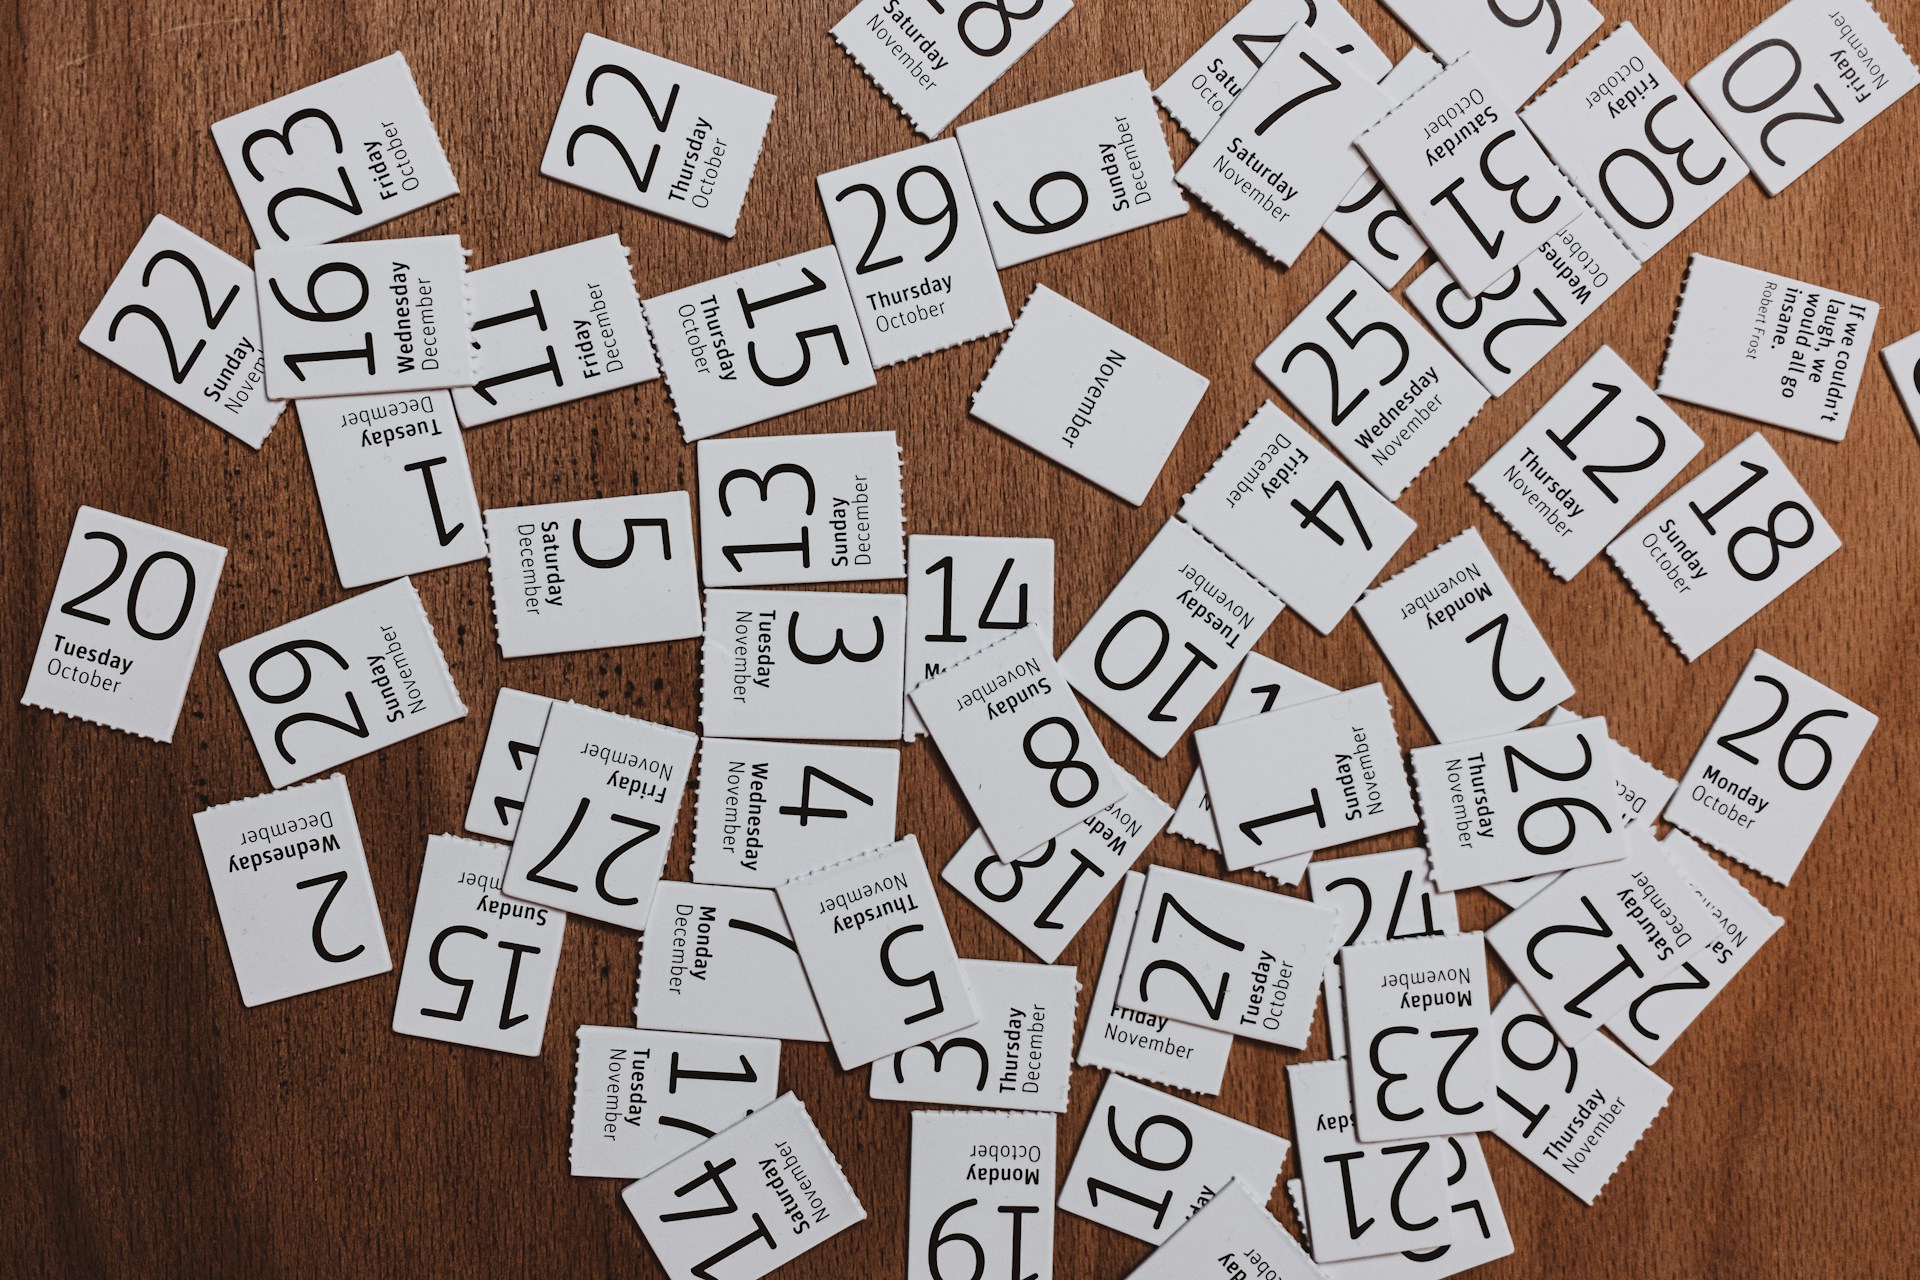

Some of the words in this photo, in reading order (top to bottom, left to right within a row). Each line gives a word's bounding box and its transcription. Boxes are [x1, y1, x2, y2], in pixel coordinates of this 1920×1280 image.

[866, 13, 937, 91] November
[883, 0, 949, 70] Saturday
[926, 0, 1044, 57] 8
[1828, 11, 1889, 90] November
[1191, 74, 1224, 113] Octo
[1207, 58, 1242, 98] Satu
[1254, 51, 1342, 137] 7
[1585, 56, 1644, 109] October
[1607, 72, 1660, 119] Friday
[1722, 38, 1845, 167] 20
[1829, 49, 1872, 103] Friday
[566, 64, 680, 193] 22
[1424, 88, 1484, 140] October
[1426, 106, 1498, 167] Saturday
[241, 108, 363, 242] 23
[363, 141, 398, 200] Friday
[381, 122, 419, 191] October
[668, 116, 713, 201] Thursday
[691, 137, 727, 208] October
[1098, 144, 1130, 212] Sunday
[1114, 116, 1152, 205] December
[1213, 154, 1290, 222] November
[1226, 137, 1299, 201] Saturday
[1598, 94, 1727, 230] 30
[835, 165, 958, 275] 29
[992, 170, 1089, 235] 6
[1430, 129, 1562, 260] 31
[866, 275, 951, 311] Thursday
[1538, 241, 1592, 305] Wednes
[1555, 229, 1608, 288] October
[108, 249, 241, 385] 22
[268, 262, 376, 382] 16
[389, 261, 415, 374] Wednesday
[415, 277, 439, 370] December
[587, 283, 624, 373] December
[678, 304, 710, 373] October
[700, 294, 737, 380] Thursday
[736, 267, 850, 387] 15
[876, 302, 945, 333] October
[1436, 264, 1567, 375] 28
[1755, 281, 1778, 324] Robert
[1771, 287, 1803, 349] insane.
[1795, 294, 1820, 348] would
[1814, 299, 1846, 352] laugh,
[1841, 323, 1858, 346] we
[1848, 303, 1867, 321] If
[203, 336, 255, 403] Sunday
[470, 289, 564, 406] 11
[573, 320, 601, 379] Friday
[1281, 289, 1410, 427] 25
[1746, 327, 1765, 359] Frost
[1788, 350, 1807, 373] all
[1808, 359, 1826, 383] we
[224, 349, 266, 415] Novem
[341, 396, 434, 428] December
[1062, 349, 1127, 449] November
[1354, 366, 1439, 449] Wednesday
[1780, 375, 1797, 398] go
[361, 419, 443, 448] Tuesday
[1371, 394, 1442, 466] November
[1545, 382, 1666, 504] 12
[404, 456, 465, 547] 1
[1226, 433, 1292, 509] December
[1261, 448, 1309, 499] Friday
[1503, 465, 1573, 537] November
[1519, 446, 1584, 518] Thursday
[572, 518, 672, 569] 5
[718, 463, 816, 573] 13
[828, 497, 850, 567] Sunday
[851, 475, 871, 565] December
[1290, 480, 1373, 551] 4
[1659, 519, 1708, 579] Sunday
[1688, 460, 1815, 582] 18
[60, 531, 196, 641] 20
[517, 524, 542, 615] December
[541, 521, 566, 606] Saturday
[924, 555, 1029, 643] 14
[1178, 564, 1255, 630] November
[1401, 563, 1481, 620] November
[1642, 533, 1691, 593] October
[787, 611, 885, 665] 3
[1176, 589, 1240, 650] Tuesday
[1426, 582, 1493, 630] Monday
[47, 658, 122, 693] October
[54, 634, 134, 675] Tuesday
[380, 626, 427, 714] November
[733, 611, 753, 704] November
[752, 609, 776, 688] Tuesday
[957, 657, 1041, 711] November
[1094, 609, 1218, 722] 10
[1465, 613, 1546, 702] 2
[248, 639, 370, 765] 29
[366, 655, 405, 723] Sunday
[987, 677, 1052, 720] Sunday
[580, 743, 673, 782] November
[1022, 716, 1100, 809] 8
[1716, 675, 1849, 791] 26
[606, 770, 667, 804] Friday
[779, 765, 874, 827] 4
[1335, 754, 1362, 821] Sunday
[1351, 726, 1384, 815] November
[1445, 759, 1473, 849] November
[1467, 752, 1495, 838] Thursday
[1503, 733, 1613, 856] 26
[1702, 765, 1770, 814] Monday
[241, 811, 333, 846] December
[722, 761, 746, 854] November
[740, 762, 769, 871] Wednesday
[1104, 803, 1143, 838] Nove
[1238, 787, 1326, 846] 1
[1692, 785, 1756, 829] October
[229, 834, 341, 873] Wednesday
[457, 871, 502, 893] mber
[526, 797, 661, 906] 27
[974, 837, 1105, 929] 18
[296, 870, 366, 963] 2
[476, 895, 549, 926] Sunday
[820, 872, 908, 915] November
[834, 894, 919, 934] Thursday
[1326, 870, 1444, 965] 24
[1616, 888, 1674, 961] Saturday
[1631, 871, 1692, 948] December
[420, 925, 541, 1030] 15
[669, 904, 694, 995] December
[689, 906, 717, 981] Monday
[880, 924, 945, 1026] 5
[1139, 892, 1246, 1021] 27
[1381, 968, 1470, 990] November
[1526, 895, 1645, 1019] 12
[1240, 950, 1277, 1025] Tuesday
[1262, 960, 1293, 1030] October
[1400, 990, 1472, 1012] Monday
[999, 1007, 1027, 1094] Thursday
[1021, 1003, 1045, 1093] December
[1104, 1022, 1194, 1059] November
[1369, 1026, 1484, 1122] 23
[1496, 1014, 1578, 1139] 19
[603, 1049, 627, 1141] November
[623, 1048, 651, 1127] Tuesday
[970, 1145, 1041, 1163] October
[1542, 1088, 1606, 1160] Thursday
[1562, 1096, 1625, 1174] November
[758, 1158, 810, 1235] Saturday
[774, 1141, 830, 1223] November
[966, 1163, 1040, 1186] Monday
[1086, 1105, 1193, 1230] 16
[1323, 1141, 1439, 1240] 21
[659, 1157, 777, 1280] 14
[928, 1198, 1040, 1280] 19
[1243, 1249, 1283, 1280] ober
